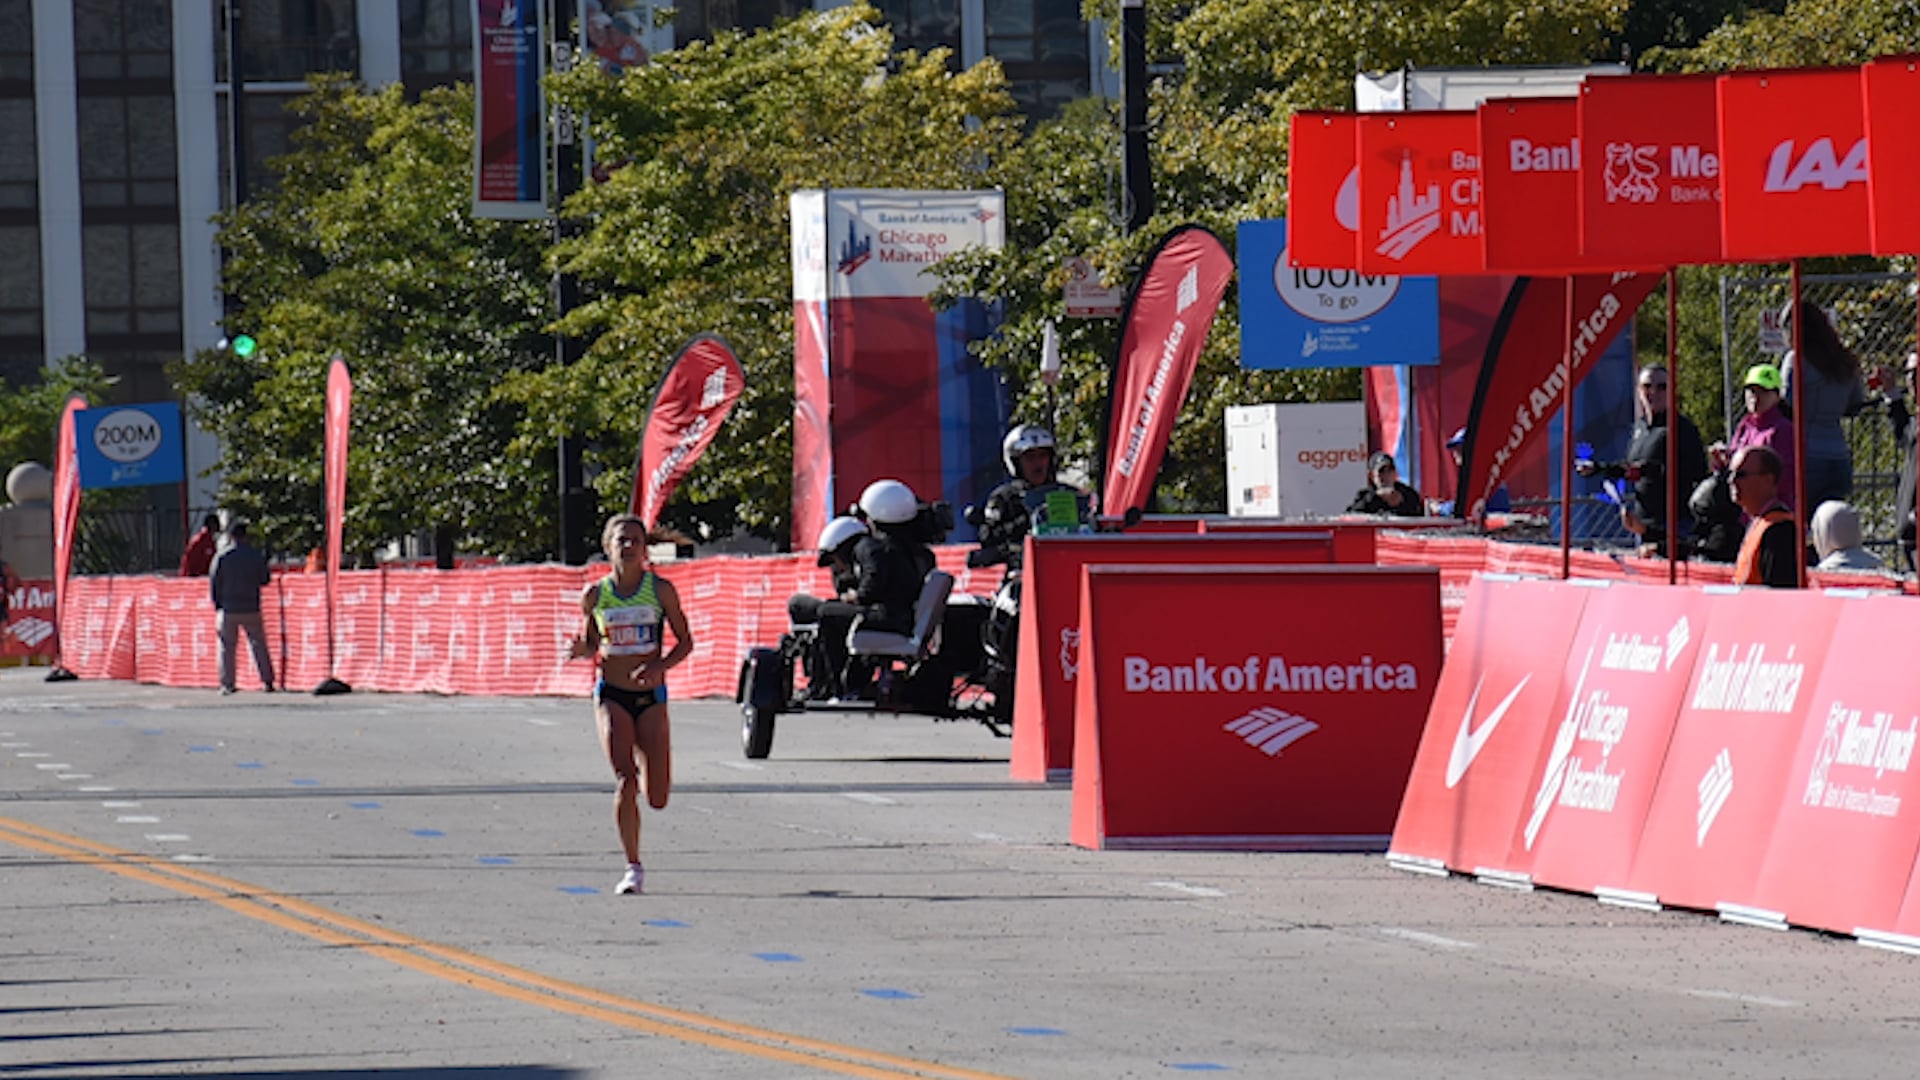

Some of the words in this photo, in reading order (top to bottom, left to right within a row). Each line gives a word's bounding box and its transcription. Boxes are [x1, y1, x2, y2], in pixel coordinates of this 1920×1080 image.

[878, 212, 906, 224] Bank
[908, 212, 921, 224] of
[922, 213, 967, 224] America
[1451, 210, 1483, 236] M
[879, 229, 948, 248] Chicago
[1317, 293, 1334, 307] To
[1339, 295, 1358, 310] go
[1146, 320, 1187, 406] America
[1140, 398, 1156, 427] of
[99, 424, 156, 446] 200M
[1117, 424, 1146, 478] Bank
[1123, 656, 1218, 692] Bank
[1221, 655, 1261, 692] of
[1263, 655, 1418, 692] America
[1691, 642, 1739, 710] Bank
[1742, 642, 1804, 713] America
[1579, 688, 1630, 758] Chicago
[1835, 708, 1887, 767] Merrill
[1874, 712, 1919, 779] Lynch
[1557, 756, 1622, 813] Marathon
